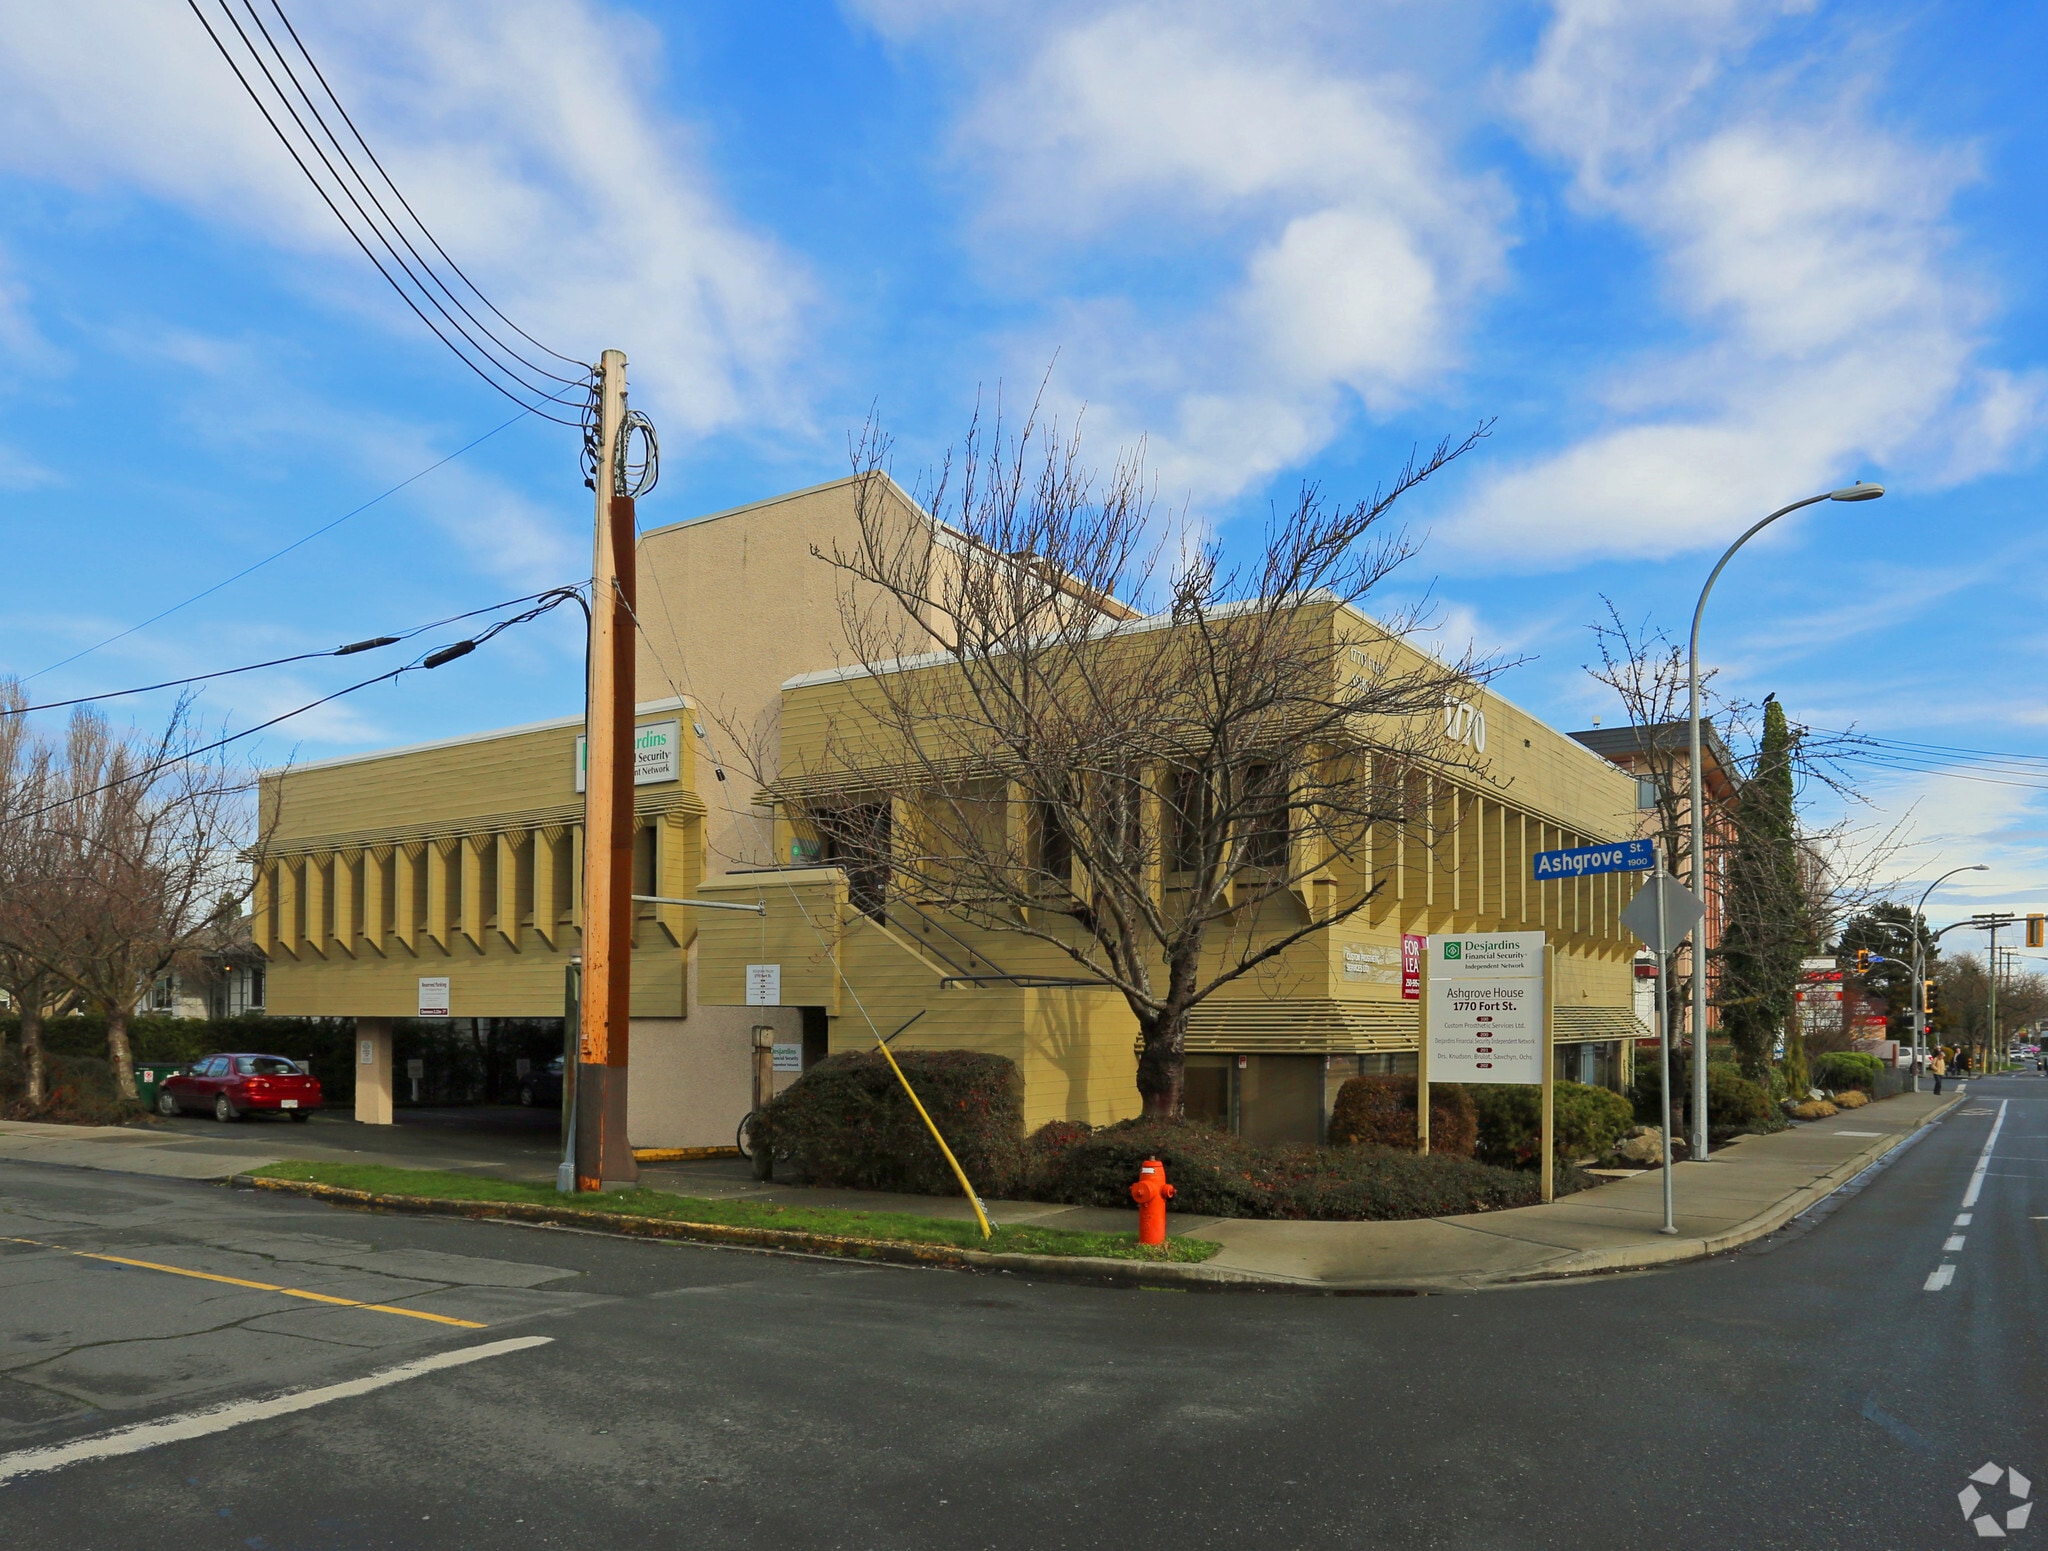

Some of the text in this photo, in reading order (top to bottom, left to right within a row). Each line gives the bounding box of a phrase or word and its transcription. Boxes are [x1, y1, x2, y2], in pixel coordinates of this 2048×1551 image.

[635, 730, 667, 749] rdins
[638, 750, 670, 762] Security
[642, 763, 670, 776] Network
[1537, 842, 1644, 876] Ashgrove St.
[1627, 858, 1648, 866] 1900
[1404, 940, 1419, 956] FOR
[1465, 940, 1520, 952] Desjardins
[1497, 952, 1525, 960] Security
[1405, 957, 1420, 973] LEA
[1447, 988, 1524, 1000] Ashgrove House
[1453, 1001, 1517, 1011] 1770 Fort St.
